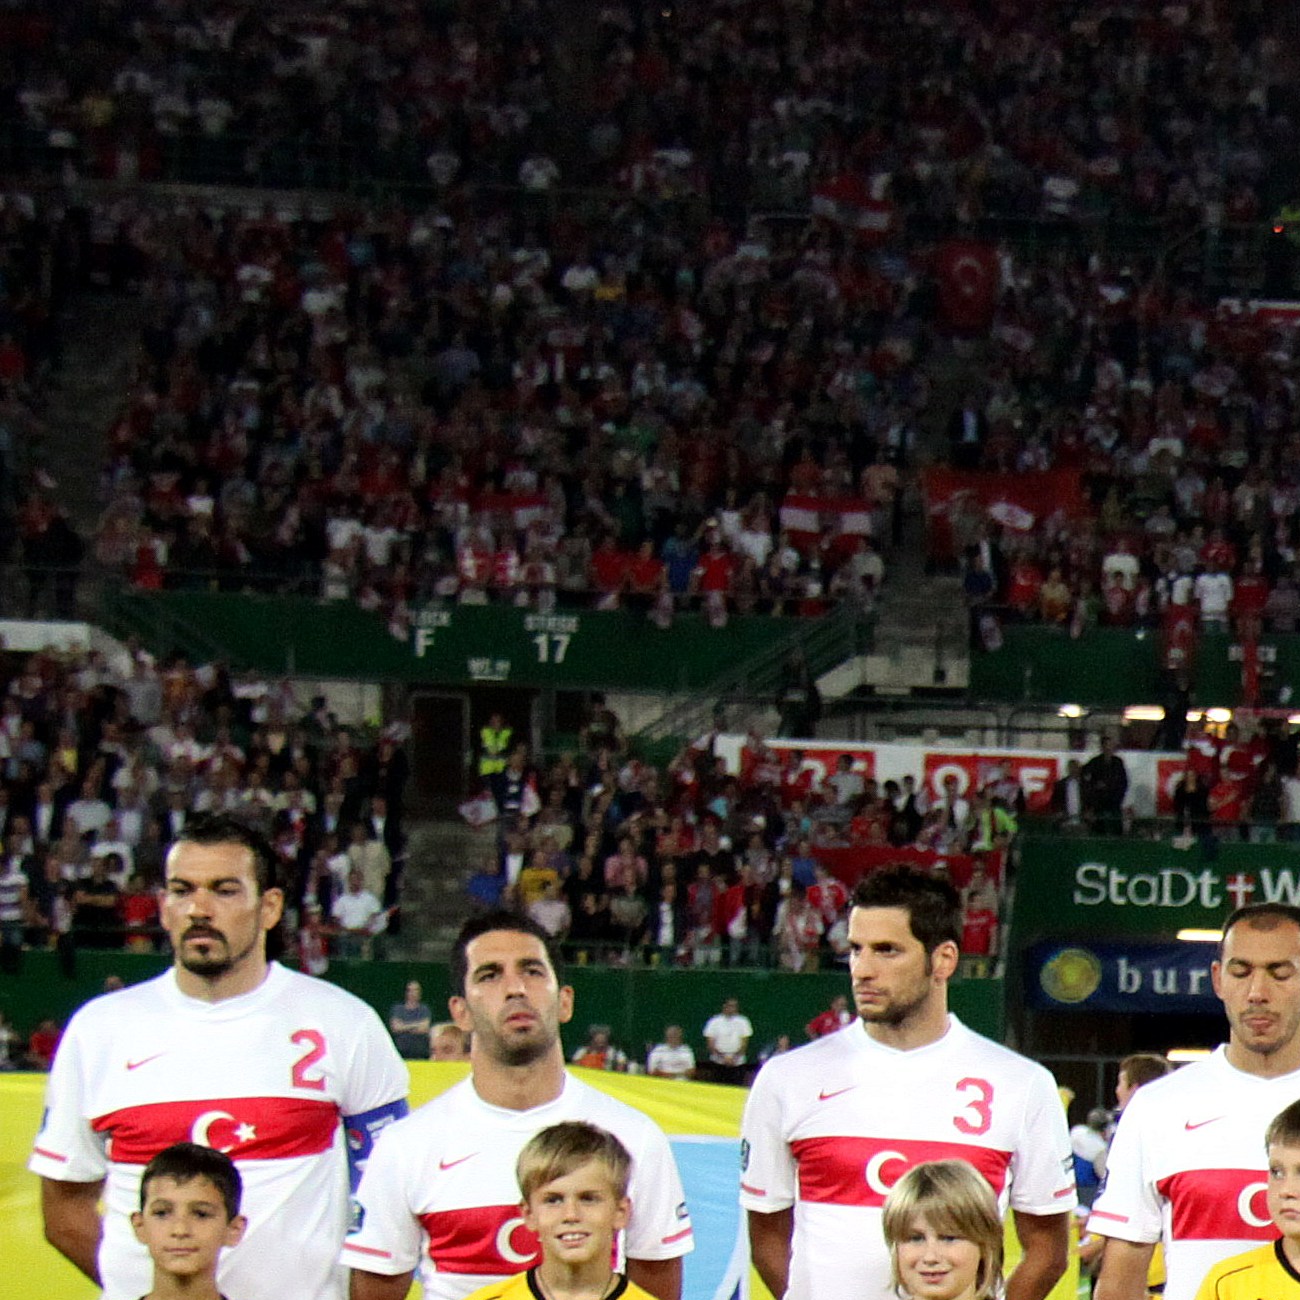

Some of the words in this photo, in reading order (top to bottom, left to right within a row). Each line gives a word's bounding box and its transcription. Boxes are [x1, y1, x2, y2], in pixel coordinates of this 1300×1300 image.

[415, 628, 435, 657] F
[532, 633, 571, 664] 17
[291, 1029, 326, 1091] 2
[953, 1077, 995, 1135] 3
